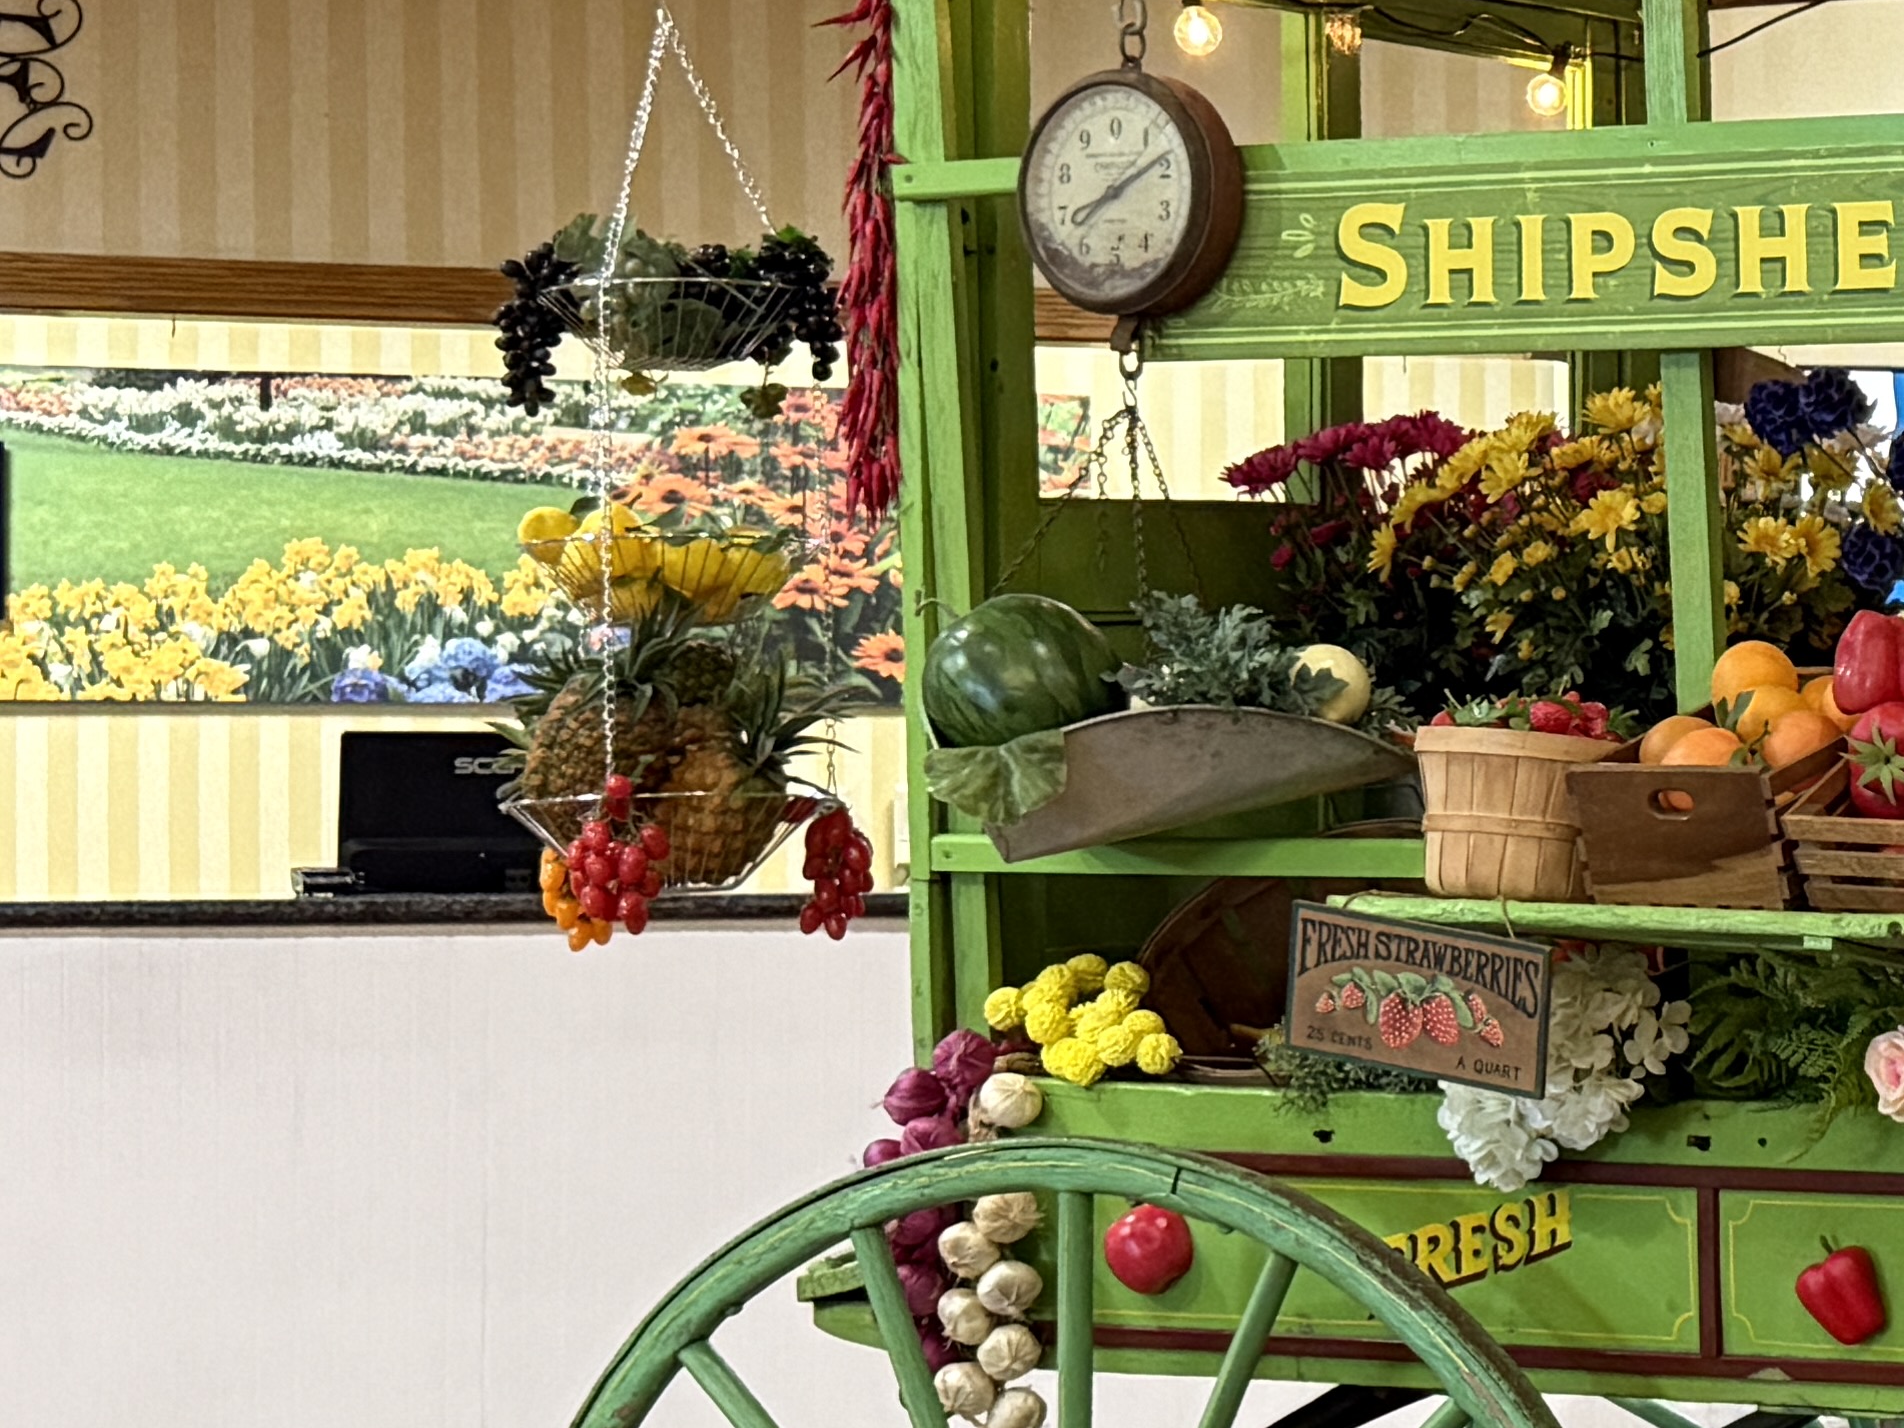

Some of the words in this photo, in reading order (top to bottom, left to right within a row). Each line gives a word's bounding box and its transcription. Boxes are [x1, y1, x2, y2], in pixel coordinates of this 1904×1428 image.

[1079, 129, 1091, 150] 9
[1109, 117, 1122, 140] 0
[1059, 162, 1071, 185] 8
[1057, 205, 1068, 226] 7
[1158, 200, 1171, 222] 3
[1079, 235, 1091, 257] 6
[1300, 917, 1370, 974] FRESH
[1375, 930, 1540, 1019] STRAWBERRIES
[1307, 1025, 1324, 1042] 25
[1331, 1031, 1373, 1051] CENTS
[1456, 1055, 1466, 1070] A
[1474, 1057, 1522, 1082] QUART
